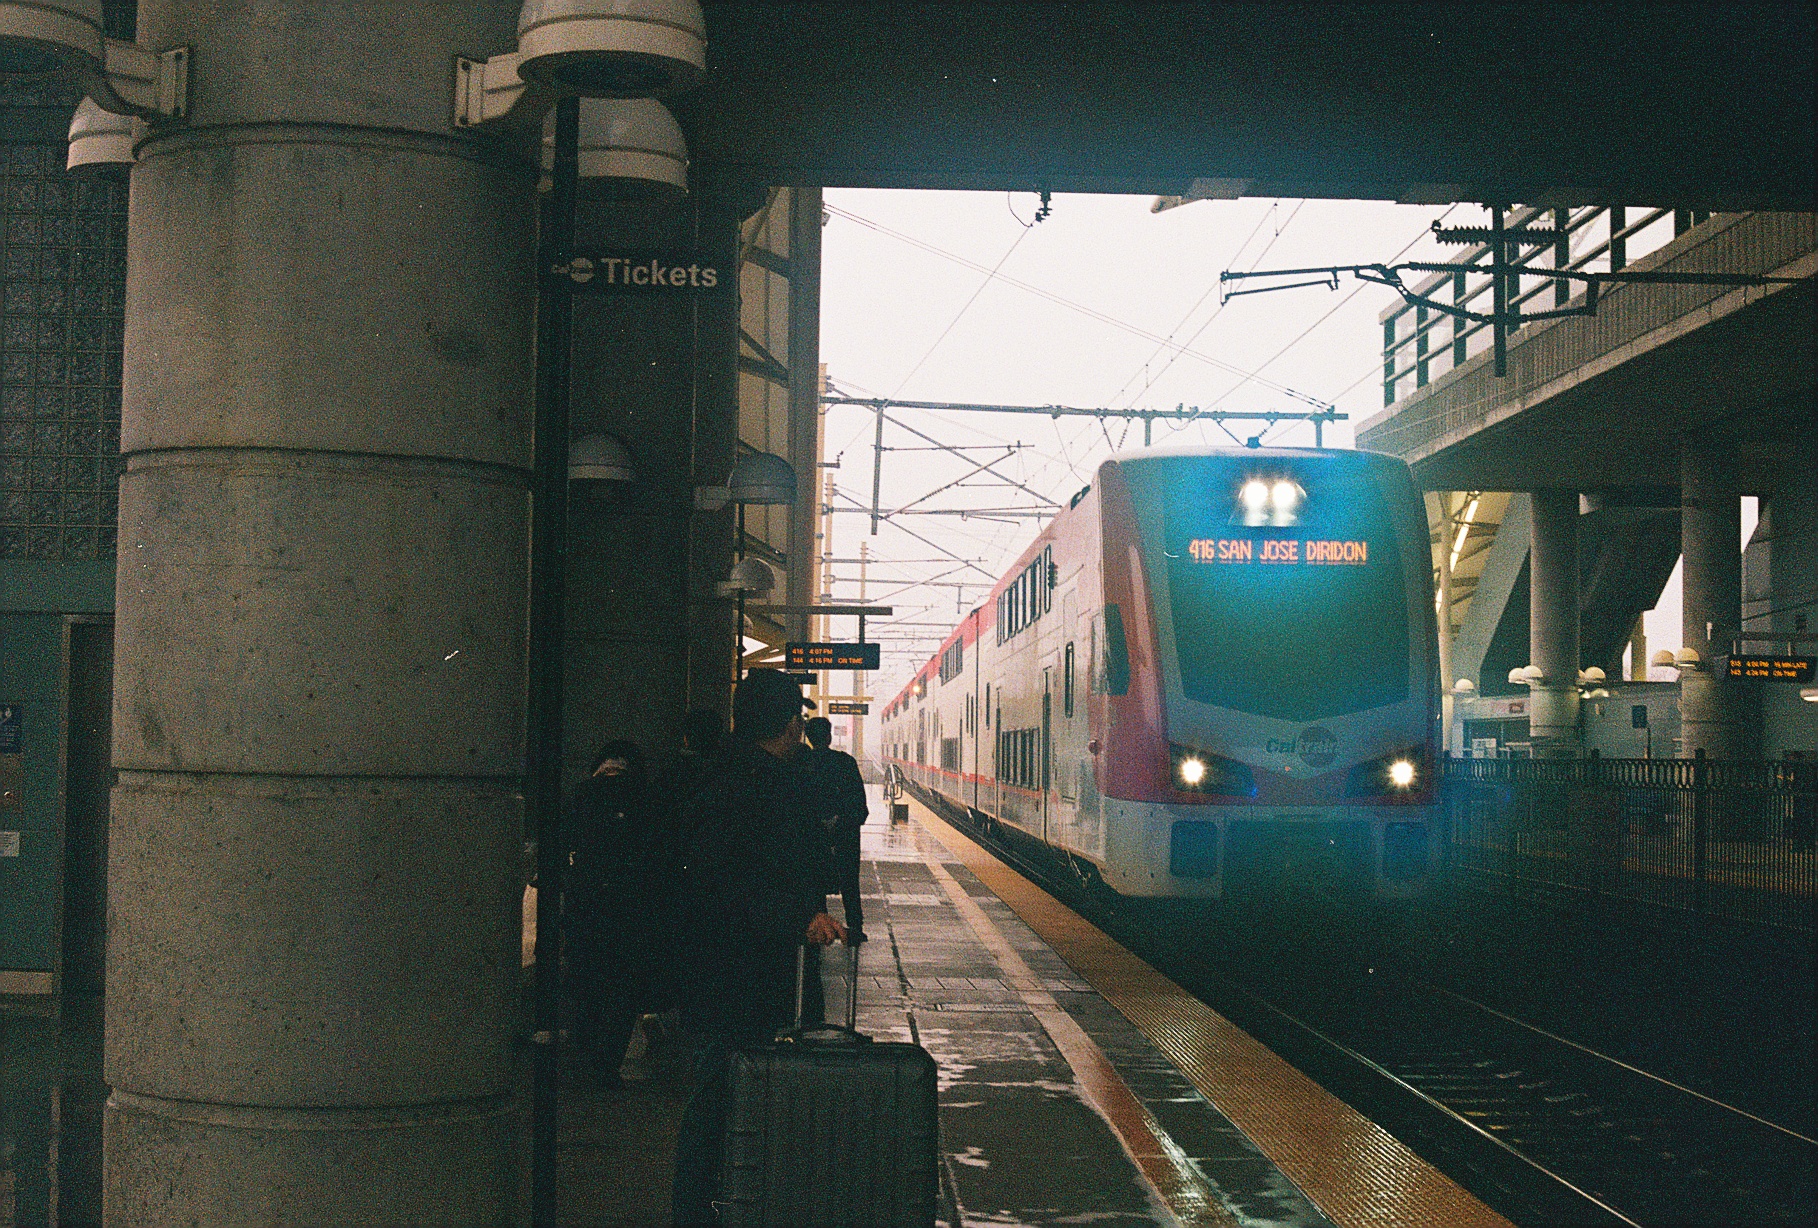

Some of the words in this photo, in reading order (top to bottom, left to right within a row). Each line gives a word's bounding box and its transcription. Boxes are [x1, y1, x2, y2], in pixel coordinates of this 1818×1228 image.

[601, 257, 718, 288] Tickets
[1188, 539, 1215, 560] 416
[1218, 539, 1252, 560] SAN
[1259, 540, 1299, 561] JOSE
[1306, 541, 1367, 561] DIRIDON
